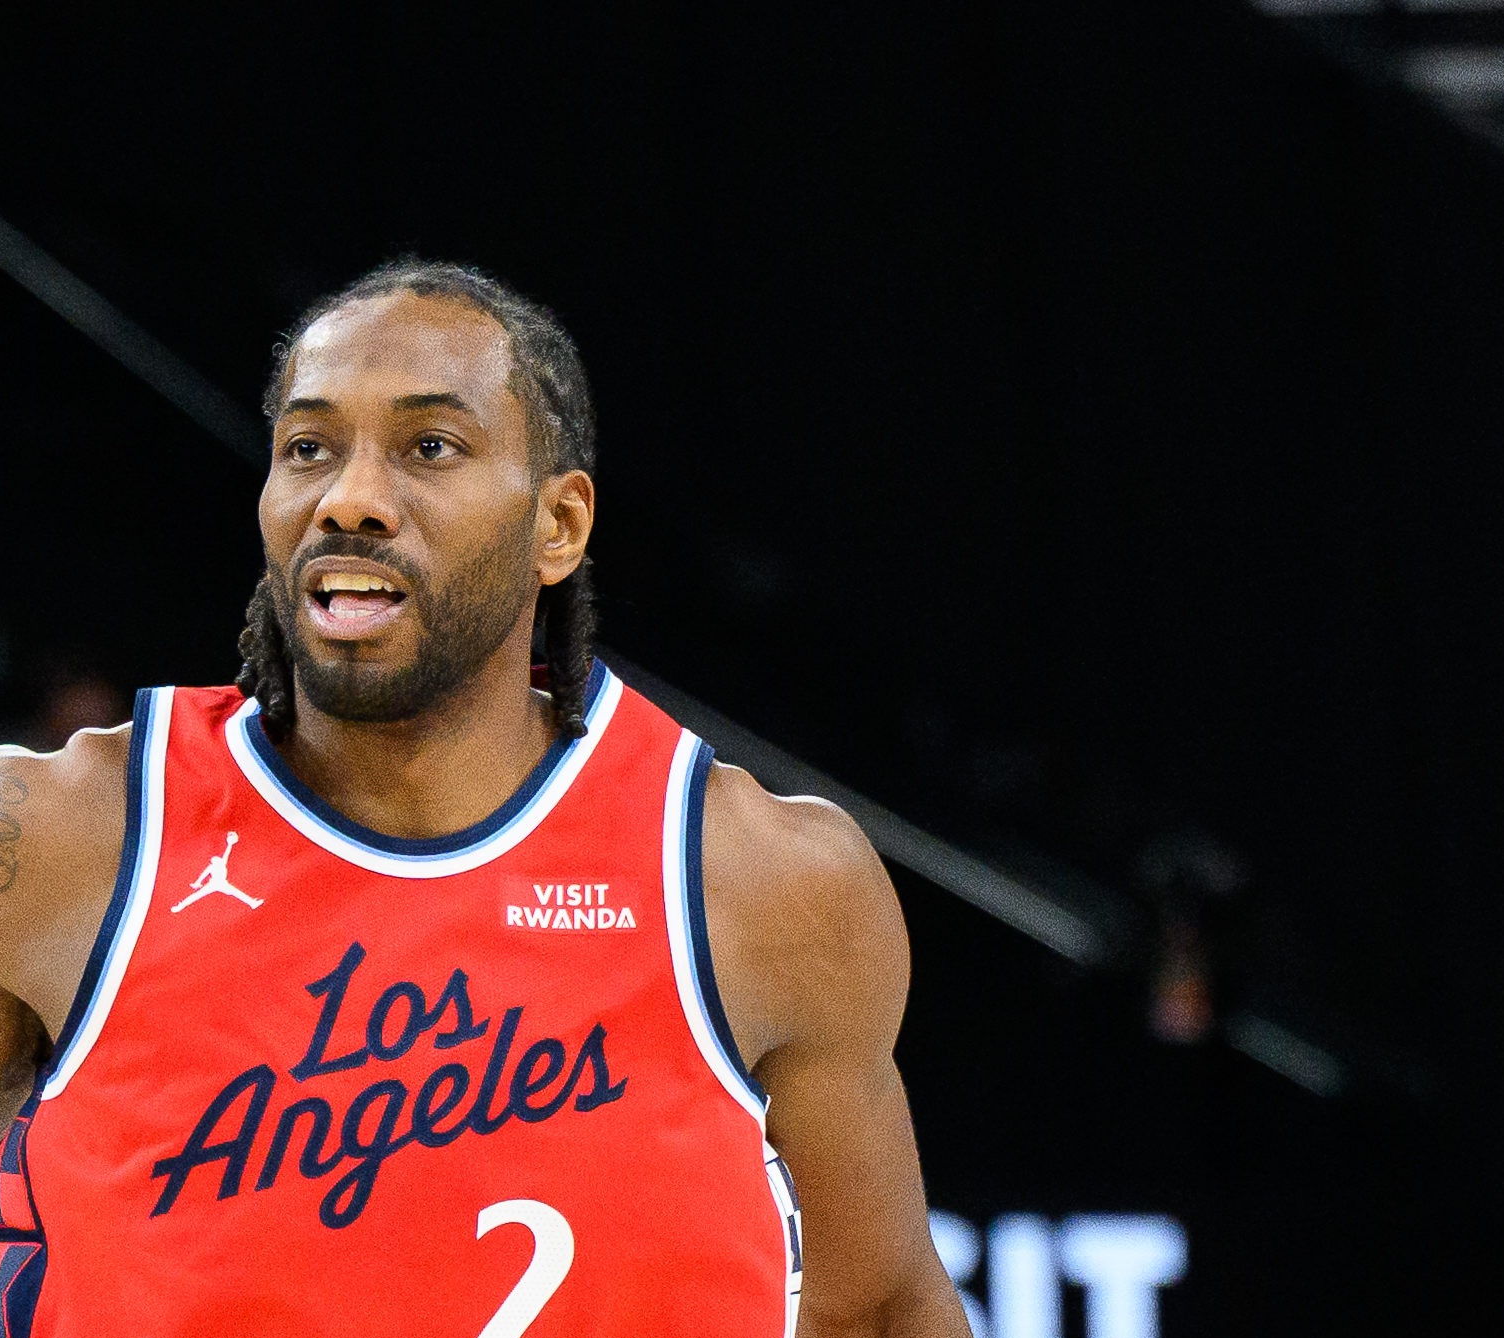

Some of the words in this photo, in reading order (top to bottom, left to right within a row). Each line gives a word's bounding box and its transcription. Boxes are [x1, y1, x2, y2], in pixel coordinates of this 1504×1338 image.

[507, 905, 637, 929] RWANDA
[533, 884, 609, 906] VISIT
[289, 941, 490, 1083] Los
[149, 1006, 628, 1230] Angeles
